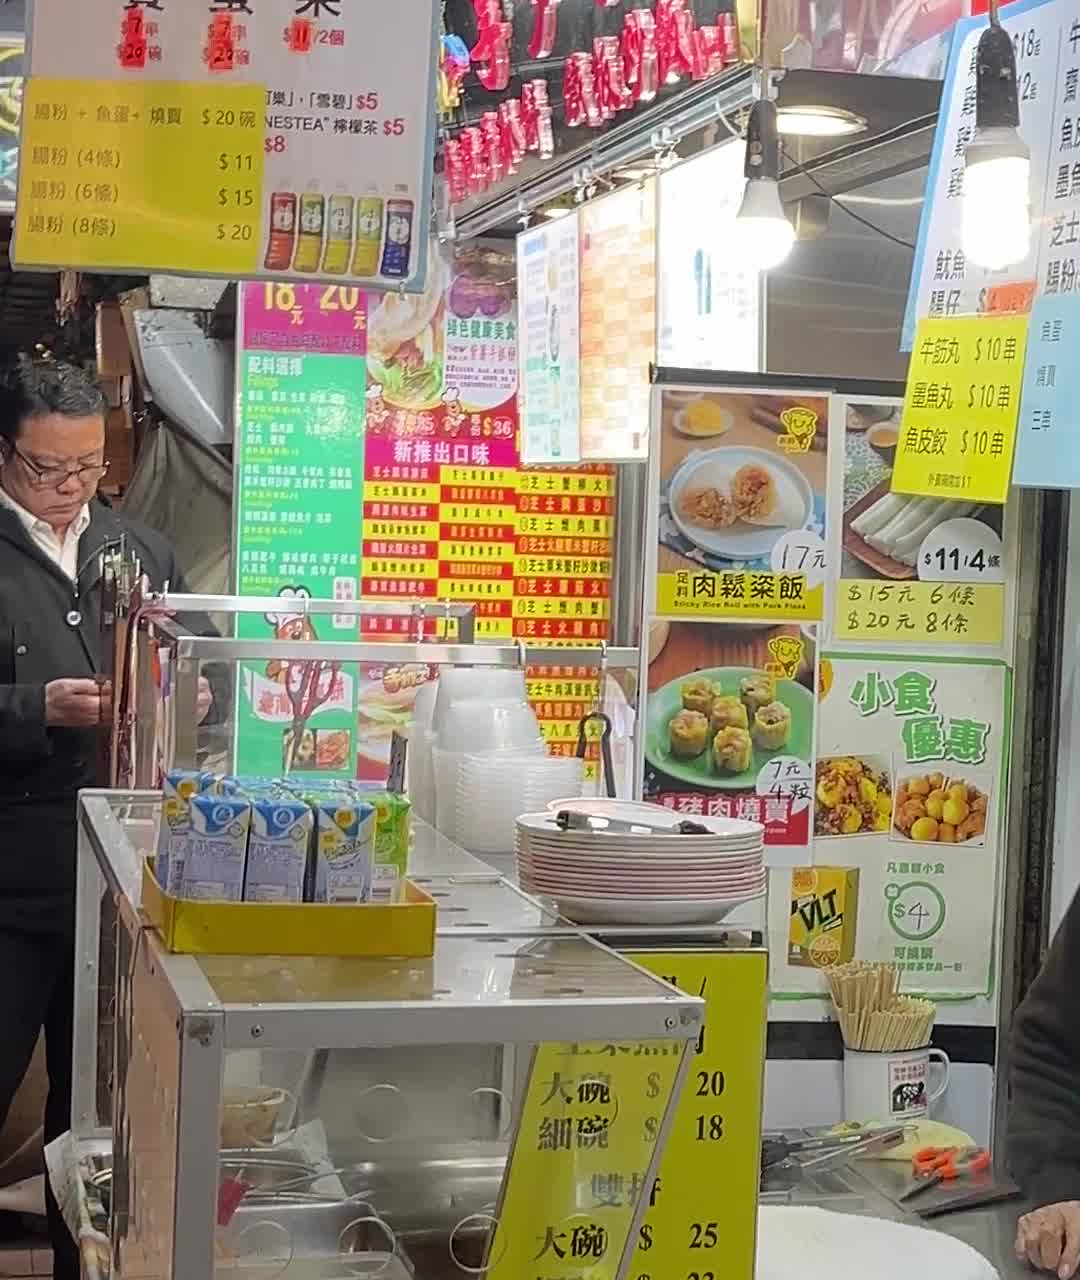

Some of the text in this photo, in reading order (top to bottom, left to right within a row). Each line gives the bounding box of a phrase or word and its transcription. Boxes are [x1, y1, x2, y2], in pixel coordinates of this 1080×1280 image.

[356, 92, 379, 110] $5
[382, 117, 406, 136] $5
[264, 135, 286, 153] $8
[919, 336, 961, 365] 牛筋丸
[911, 382, 953, 410] 墨魚丸
[393, 441, 490, 465] 新推出口味
[904, 426, 948, 456] 魚皮餃
[692, 573, 805, 601] 肉鬆粢飯
[850, 670, 935, 715] 小食
[901, 714, 990, 765] 優惠
[541, 1069, 611, 1106] 大碗
[695, 1070, 725, 1097] 20
[537, 1114, 609, 1151] 細碗
[695, 1115, 724, 1141] 18
[534, 1223, 607, 1261] 大碗
[688, 1222, 719, 1249] 25
